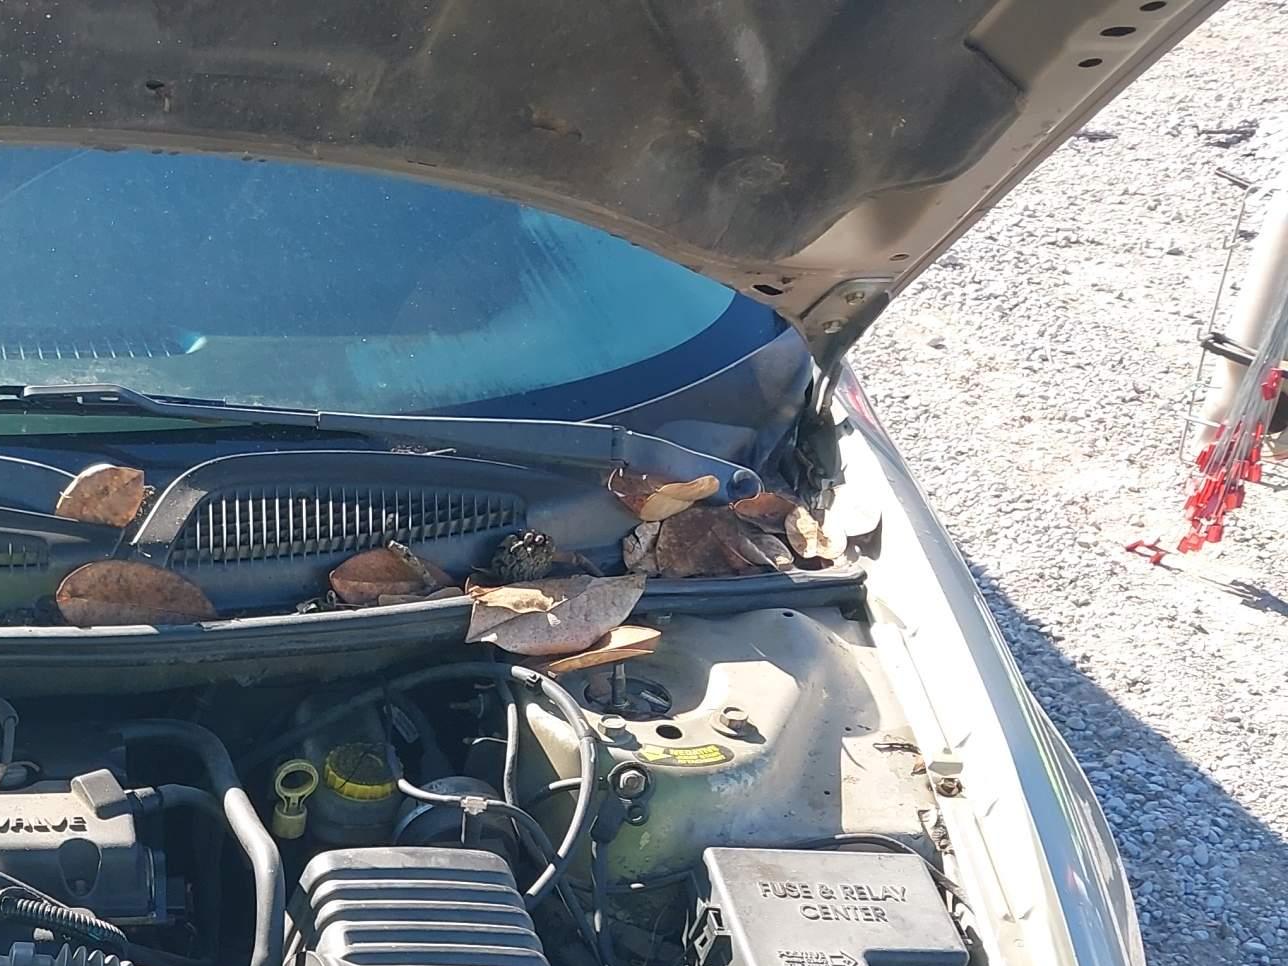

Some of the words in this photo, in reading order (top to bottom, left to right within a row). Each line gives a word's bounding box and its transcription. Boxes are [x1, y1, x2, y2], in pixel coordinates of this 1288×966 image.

[759, 881, 814, 899] FUSE
[818, 884, 836, 900] &
[840, 884, 907, 902] RELAY
[800, 904, 888, 922] CENTER
